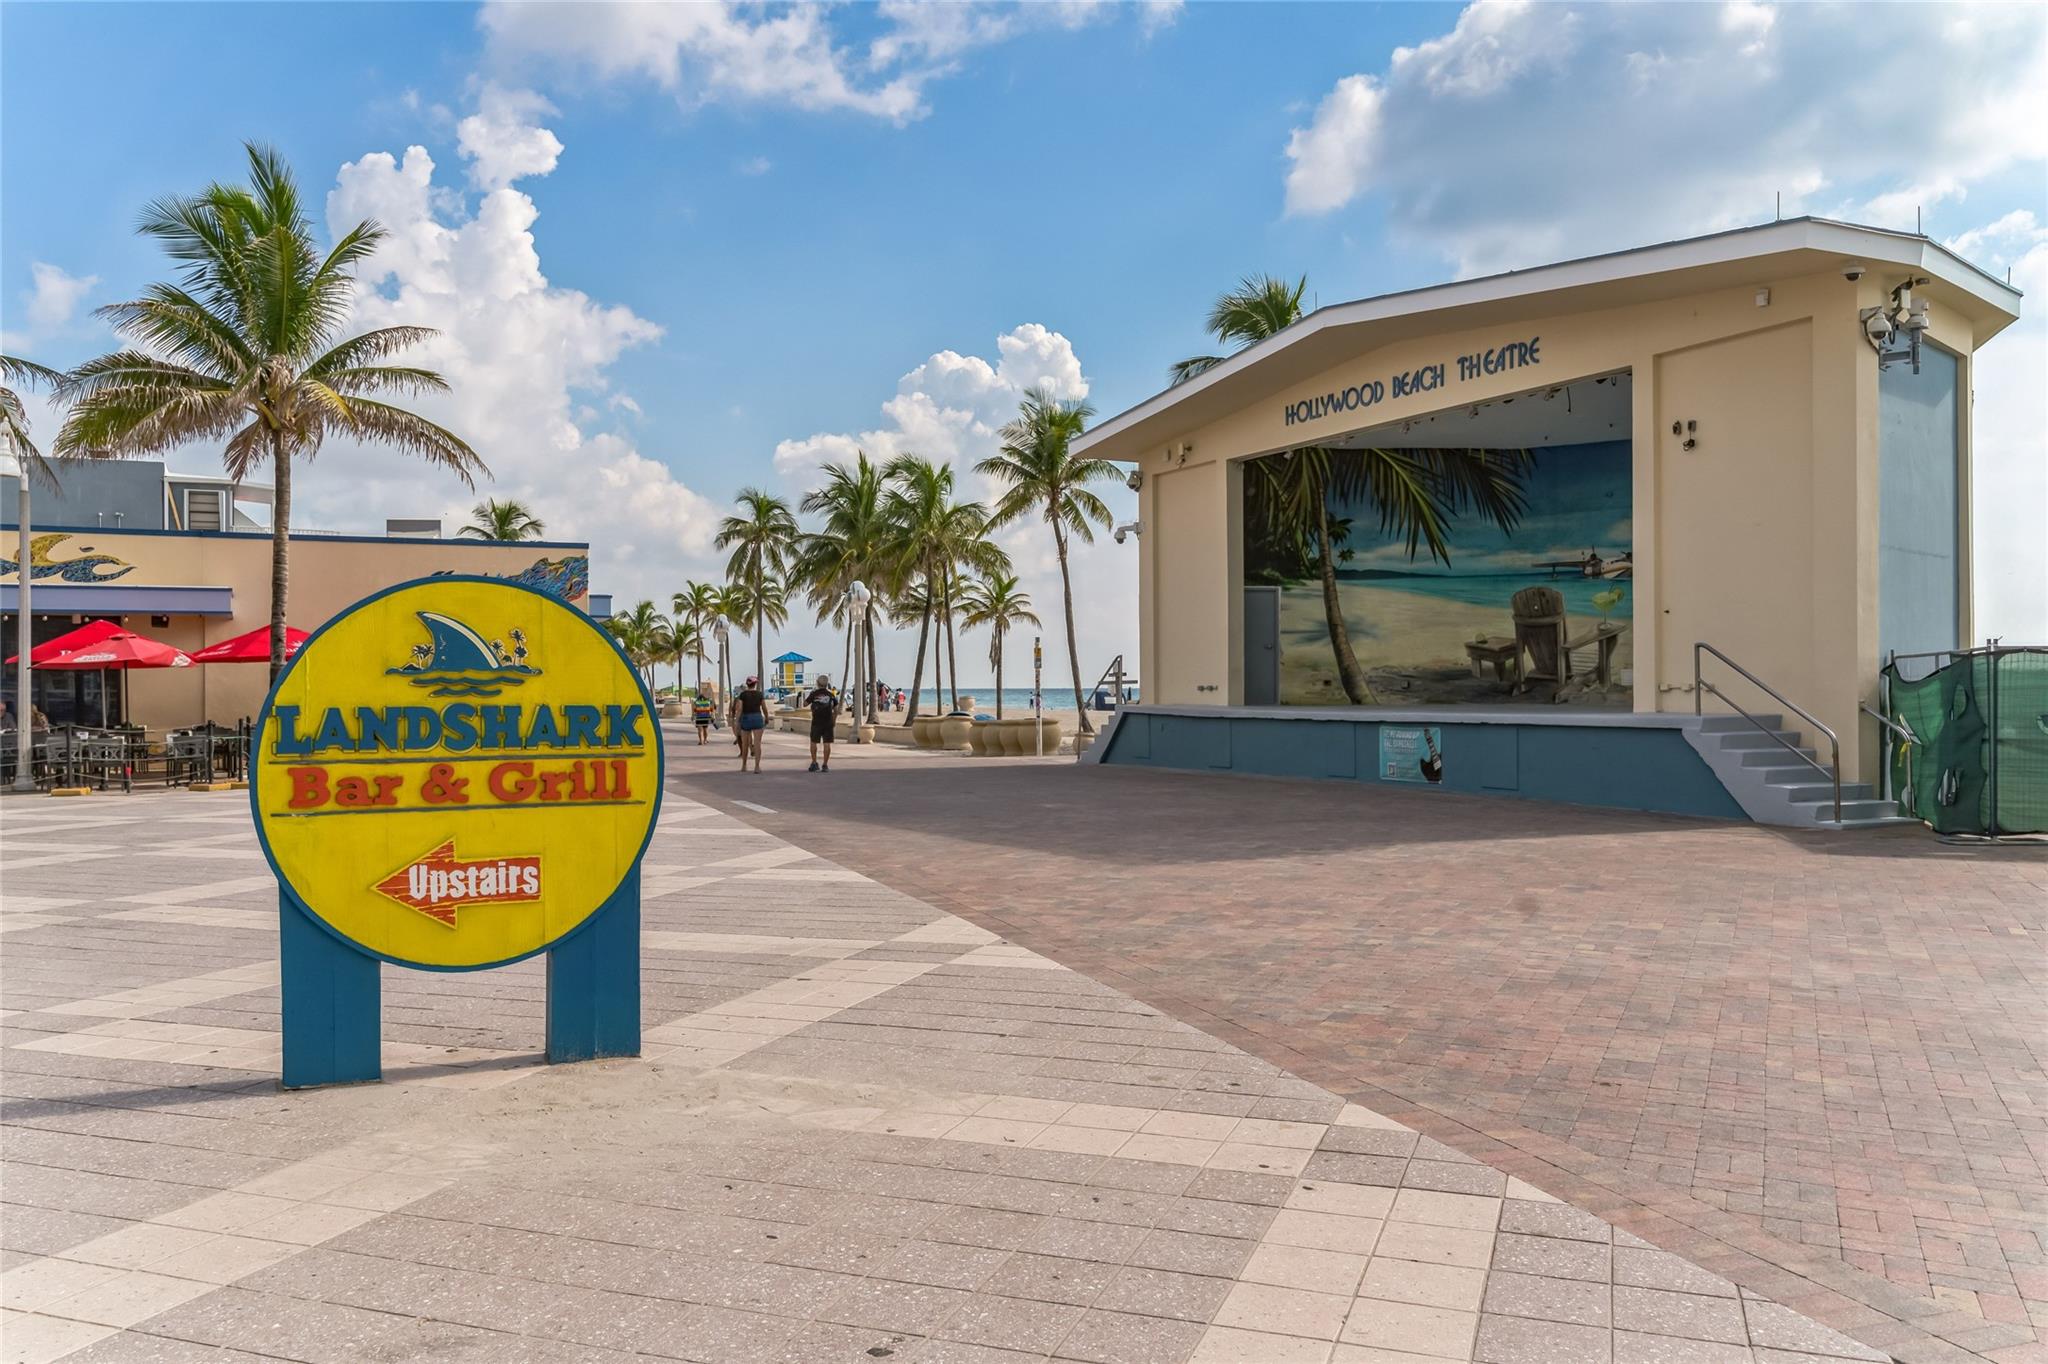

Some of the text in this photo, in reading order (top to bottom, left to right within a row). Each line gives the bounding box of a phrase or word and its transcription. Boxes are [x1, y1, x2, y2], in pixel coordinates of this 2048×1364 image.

[1285, 336, 1541, 426] HOLLYWOOD BEACH THEATRE
[272, 702, 644, 756] LANDSHARK
[288, 760, 632, 809] Bar & Grill
[408, 861, 539, 903] Upstairs
